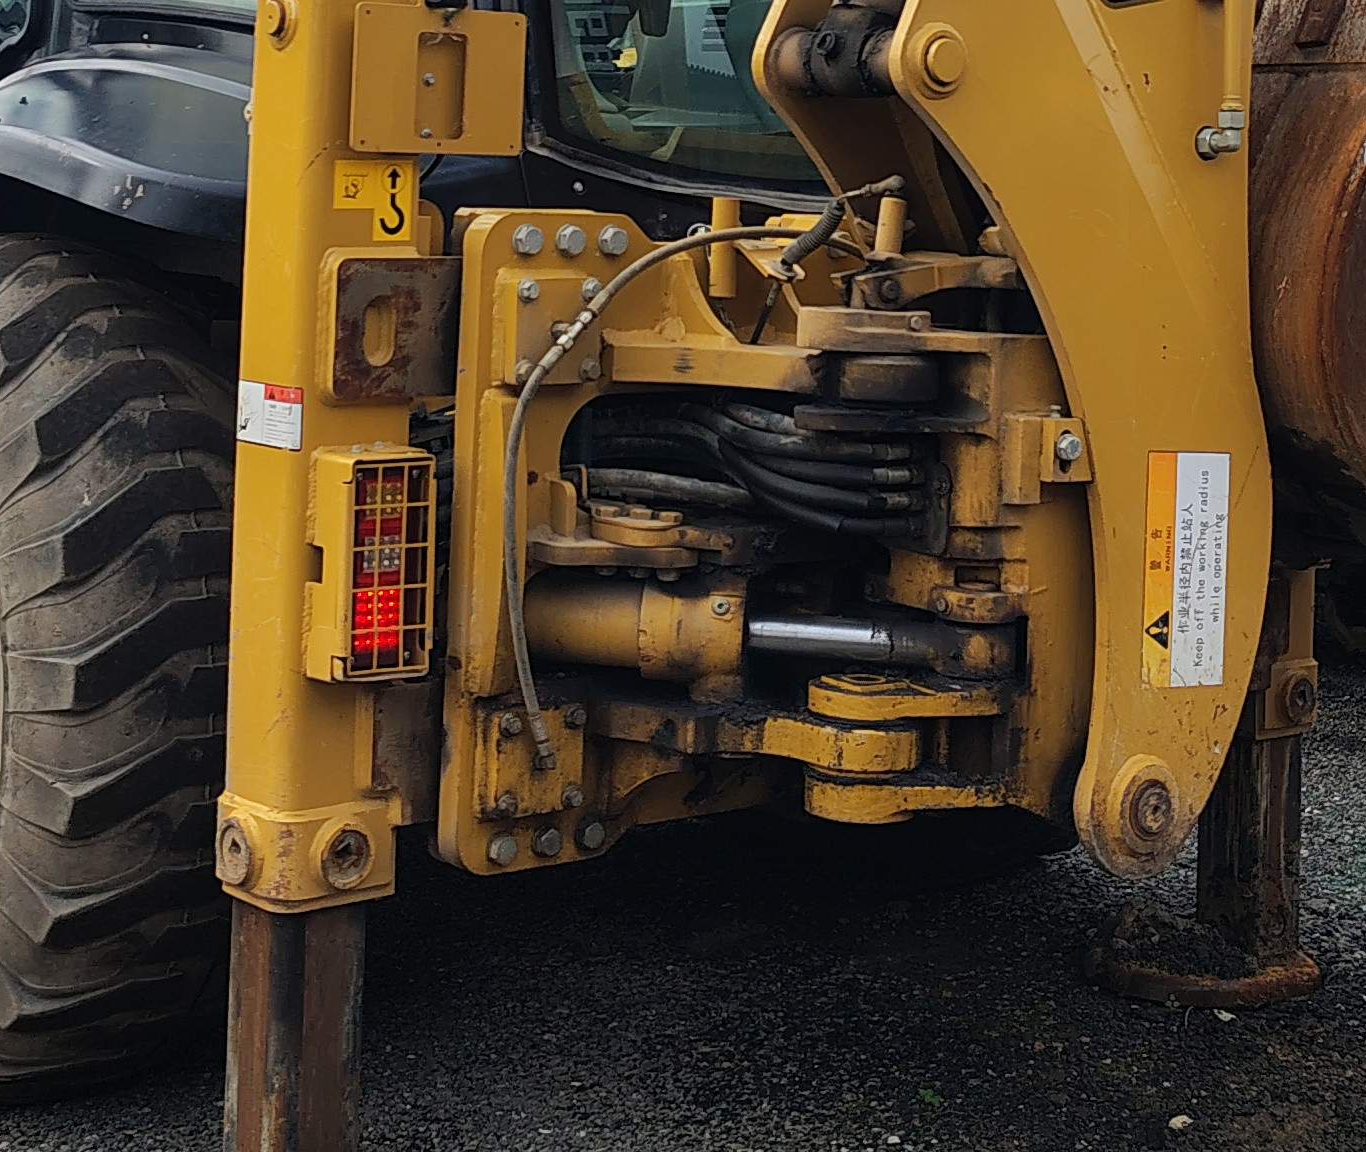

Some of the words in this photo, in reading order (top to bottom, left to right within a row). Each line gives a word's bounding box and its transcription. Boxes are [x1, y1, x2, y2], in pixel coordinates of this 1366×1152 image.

[1199, 469, 1210, 514] radius
[1150, 528, 1163, 571] 警告
[1198, 520, 1210, 573] working
[1213, 513, 1227, 579] operating
[1178, 503, 1194, 635] 作业半径内禁止站人
[1196, 573, 1207, 602] the
[1195, 609, 1205, 631] off
[1211, 585, 1222, 623] while
[1192, 638, 1205, 668] Keep
